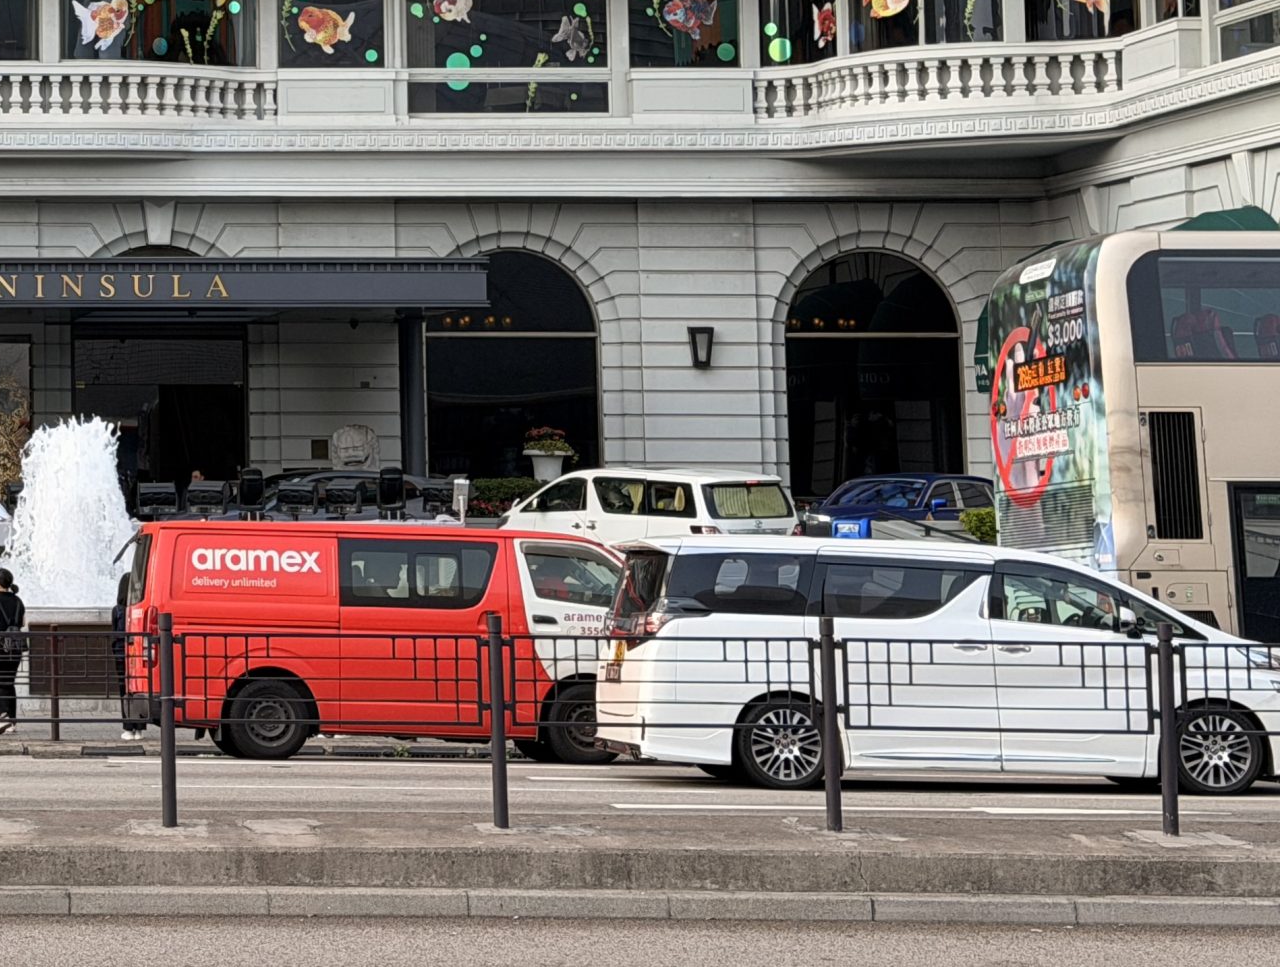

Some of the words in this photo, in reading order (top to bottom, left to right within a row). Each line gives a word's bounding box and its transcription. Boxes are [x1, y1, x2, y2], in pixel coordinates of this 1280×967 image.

[1047, 318, 1083, 347] $3,000
[192, 548, 321, 573] aramex
[192, 576, 229, 589] delivery
[231, 577, 277, 588] unlimited
